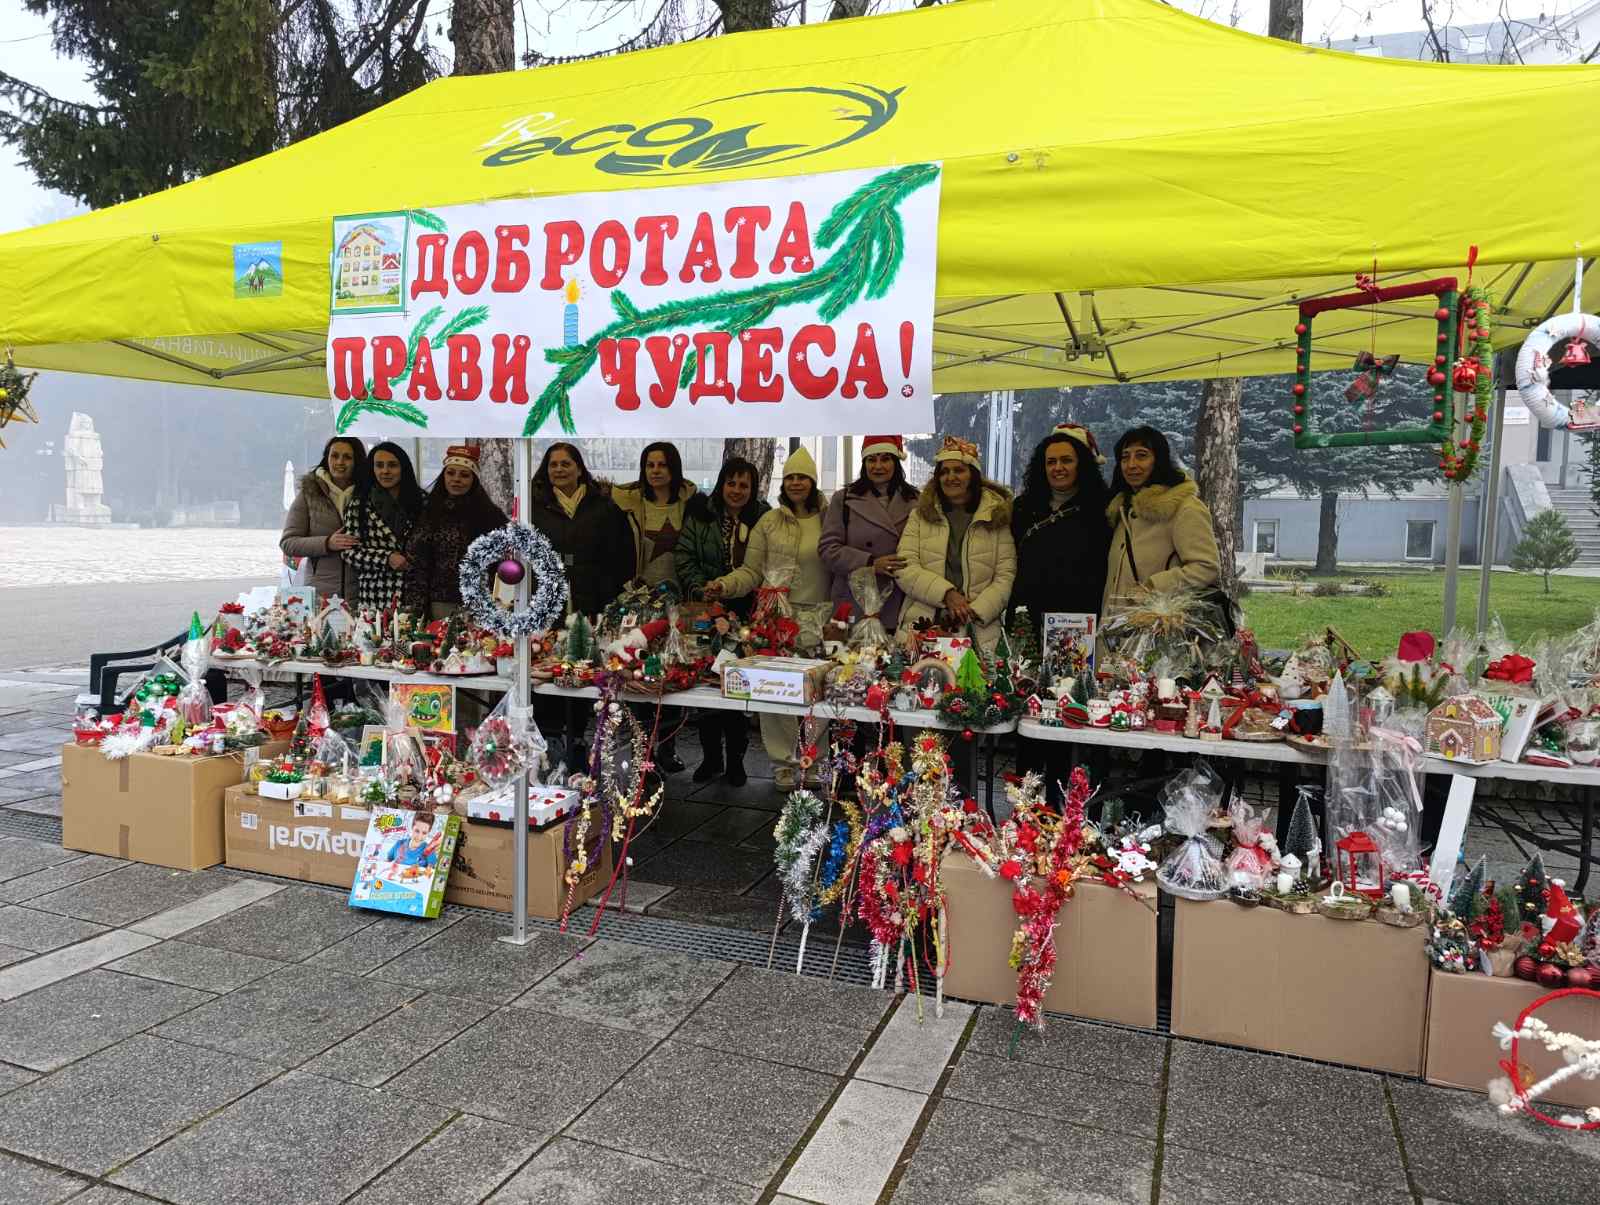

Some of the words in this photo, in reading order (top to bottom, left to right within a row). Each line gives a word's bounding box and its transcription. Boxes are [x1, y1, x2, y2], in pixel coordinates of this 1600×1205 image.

[411, 201, 814, 300] ДОБРОТАТА
[332, 333, 531, 405] ПРАВИ
[600, 321, 914, 411] ЧУДЕСА!
